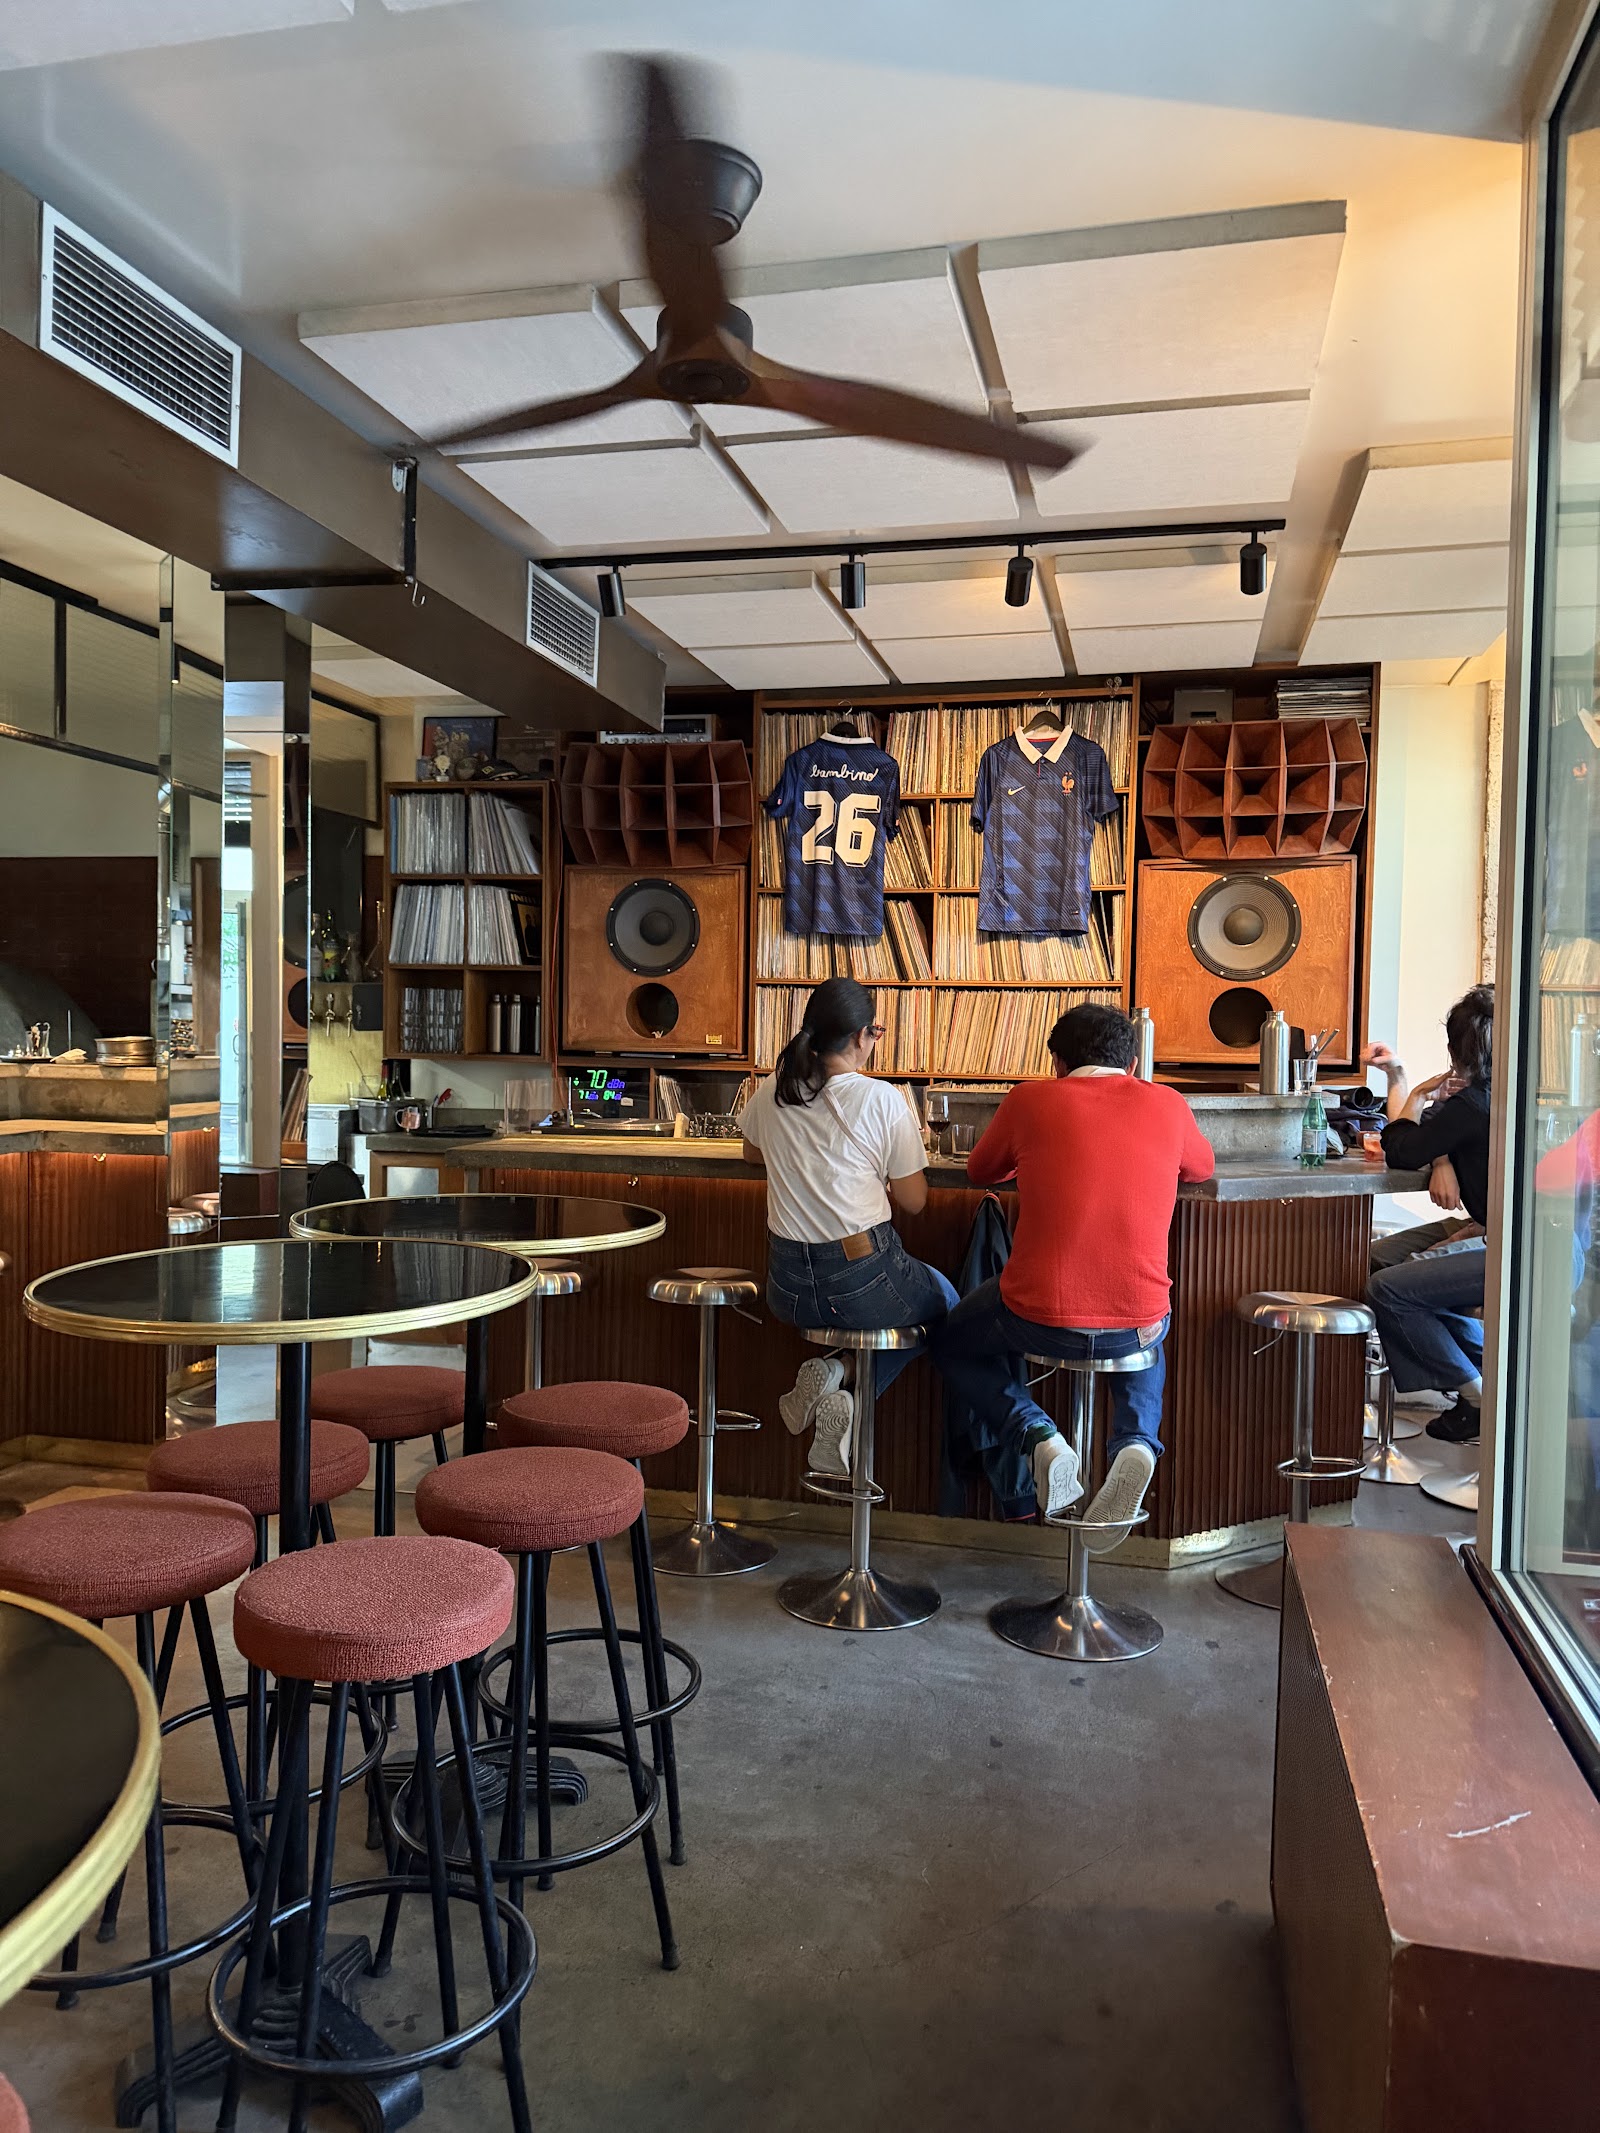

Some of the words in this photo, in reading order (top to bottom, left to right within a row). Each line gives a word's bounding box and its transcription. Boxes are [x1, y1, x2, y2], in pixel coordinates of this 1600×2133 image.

[810, 764, 879, 782] bambino
[802, 790, 881, 868] 26
[586, 1069, 608, 1089] 70
